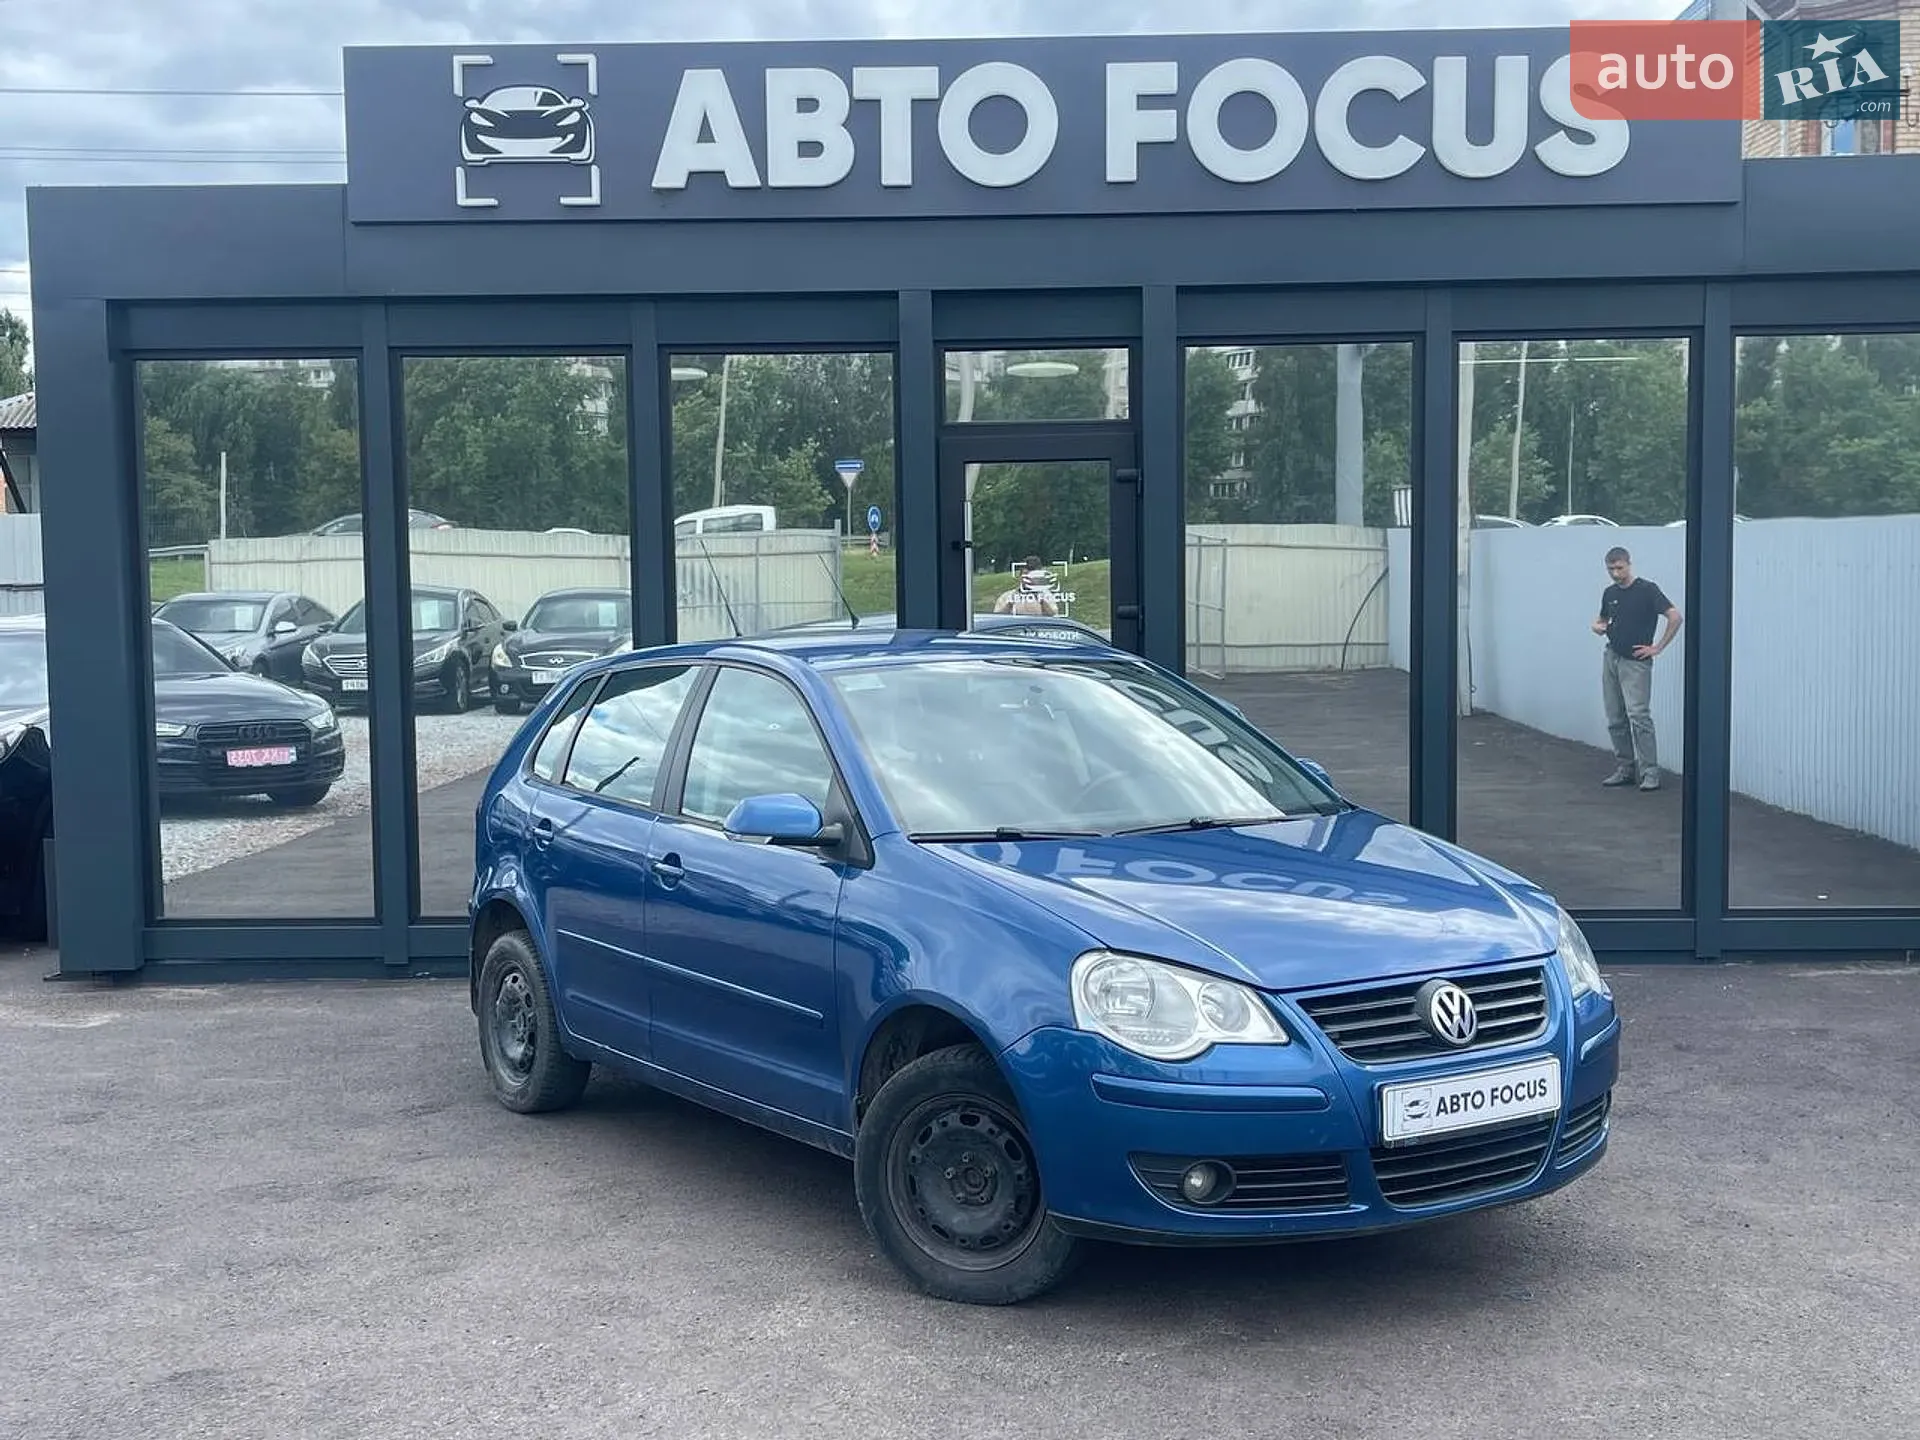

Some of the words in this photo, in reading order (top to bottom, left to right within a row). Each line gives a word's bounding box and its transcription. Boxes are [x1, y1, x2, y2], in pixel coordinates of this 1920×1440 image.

[651, 61, 1059, 188] АВТО
[1105, 51, 1630, 183] FOCUS
[1037, 592, 1076, 602] FOCUS
[1436, 1090, 1485, 1117] АВТО
[1490, 1078, 1548, 1107] FOCUS
